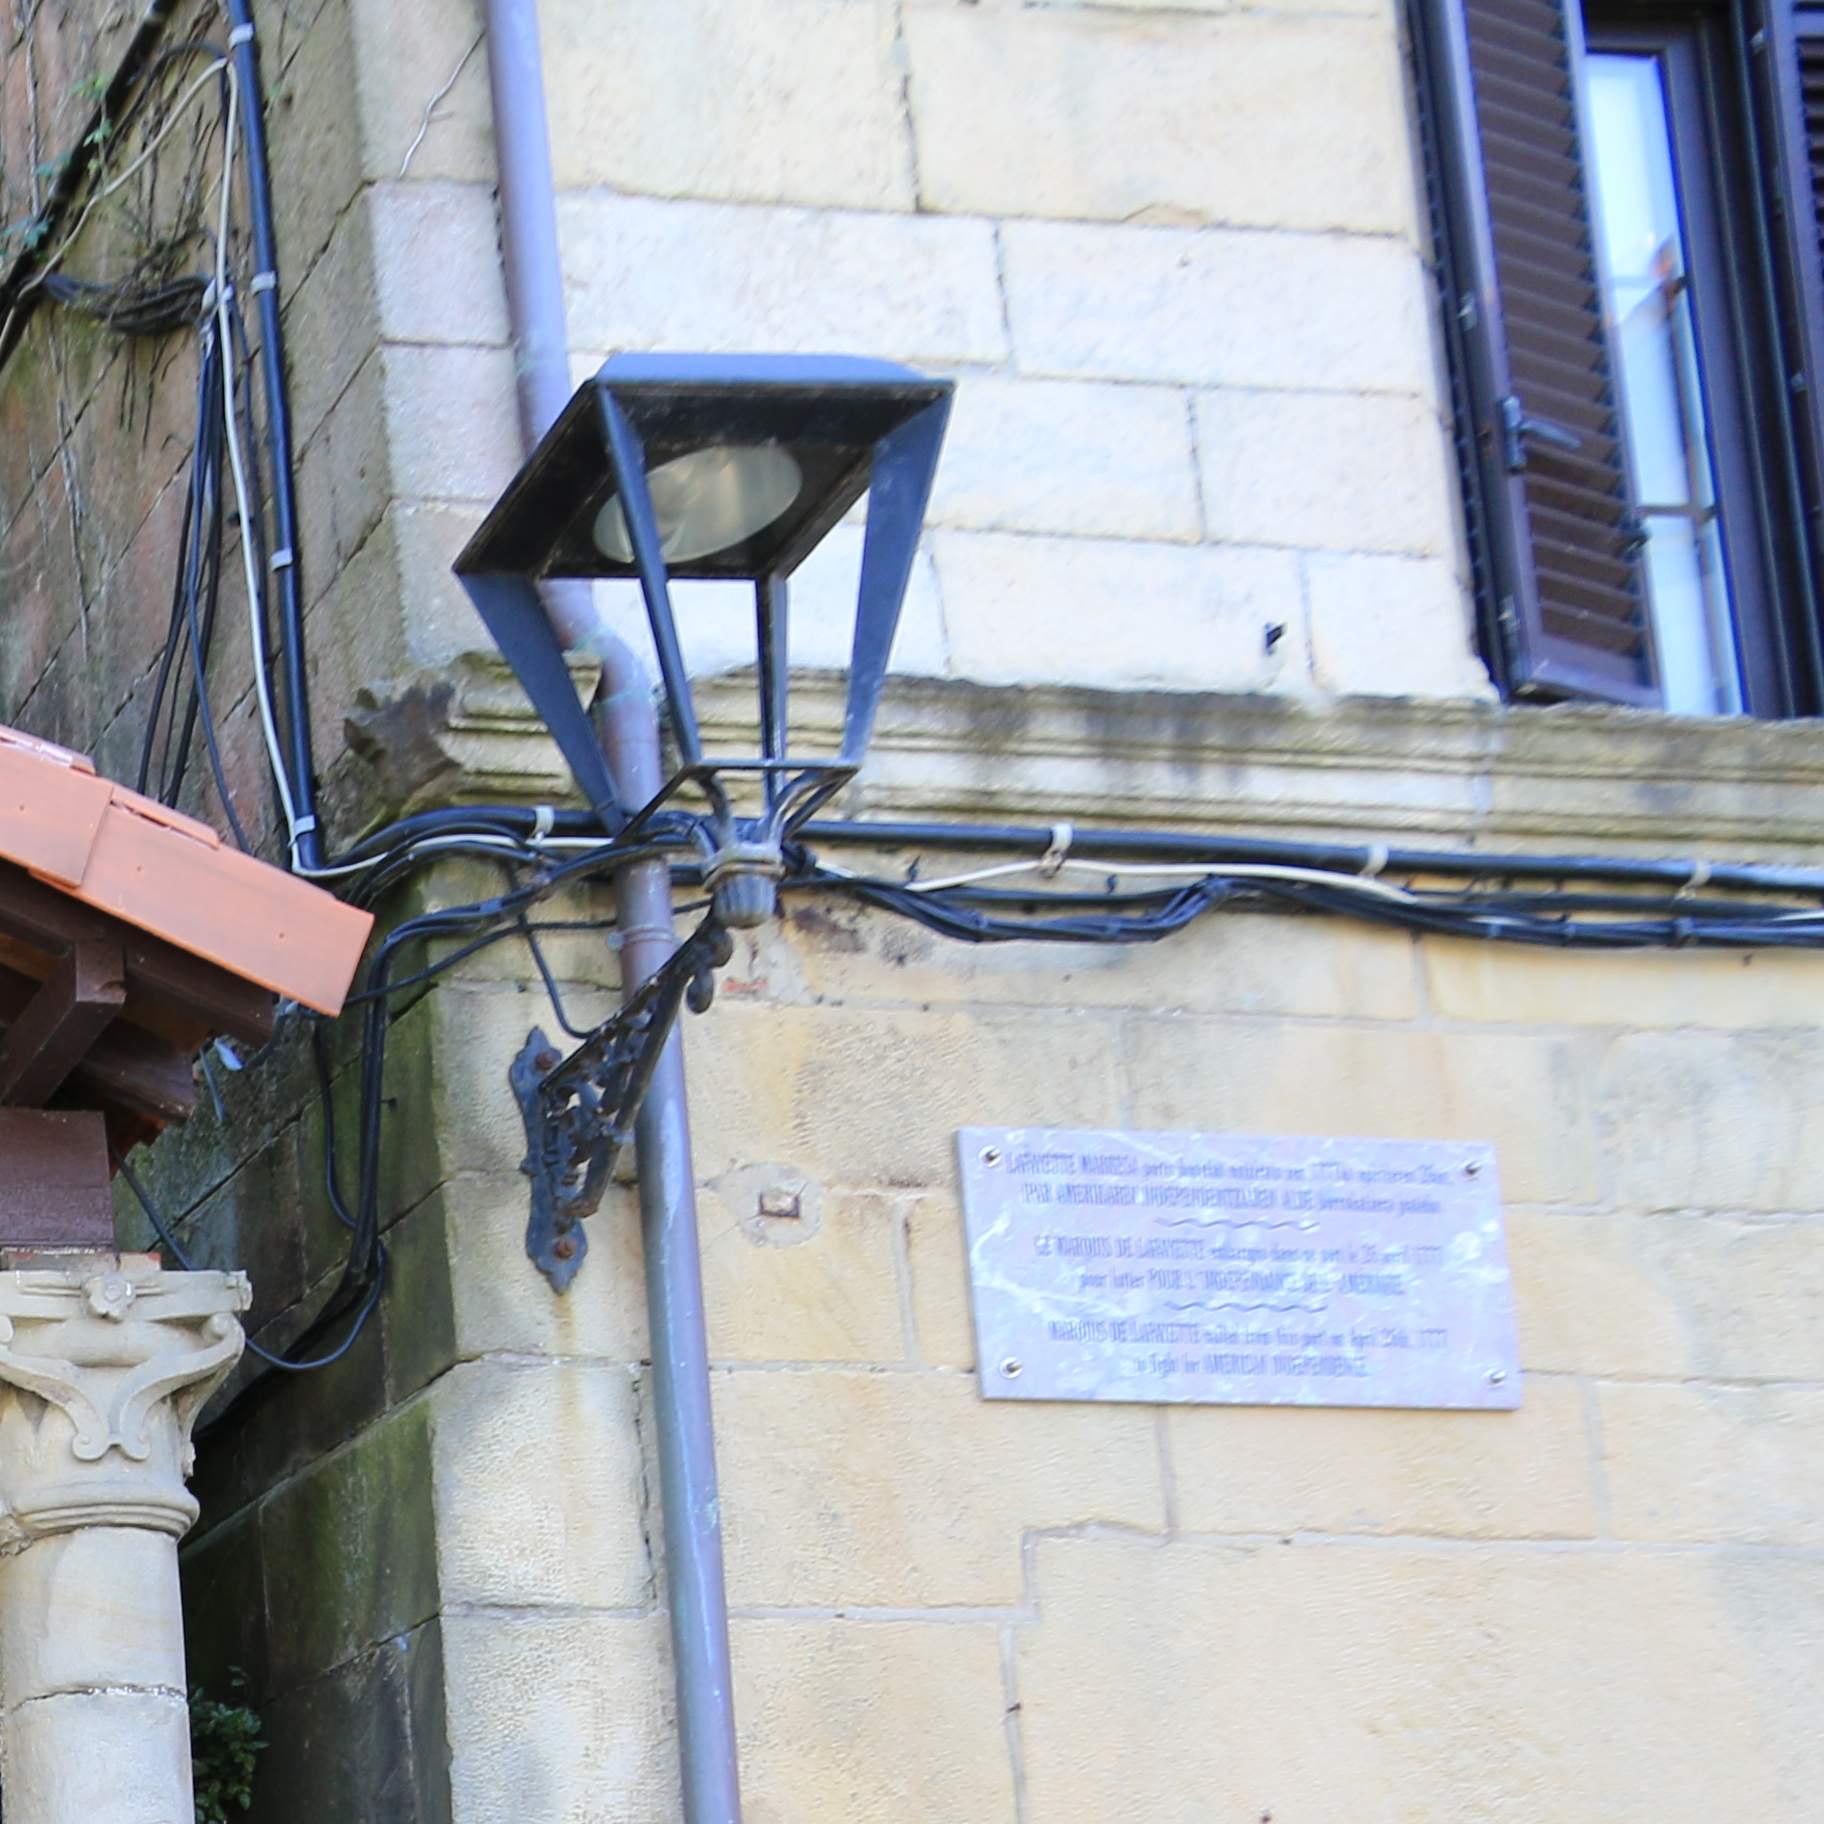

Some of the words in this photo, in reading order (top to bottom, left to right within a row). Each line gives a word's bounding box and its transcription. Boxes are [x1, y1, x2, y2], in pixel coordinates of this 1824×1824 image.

[1048, 1320, 1106, 1341] MARQUIS
[1109, 1320, 1127, 1341] DE
[1130, 1321, 1200, 1343] LAFAYETTE
